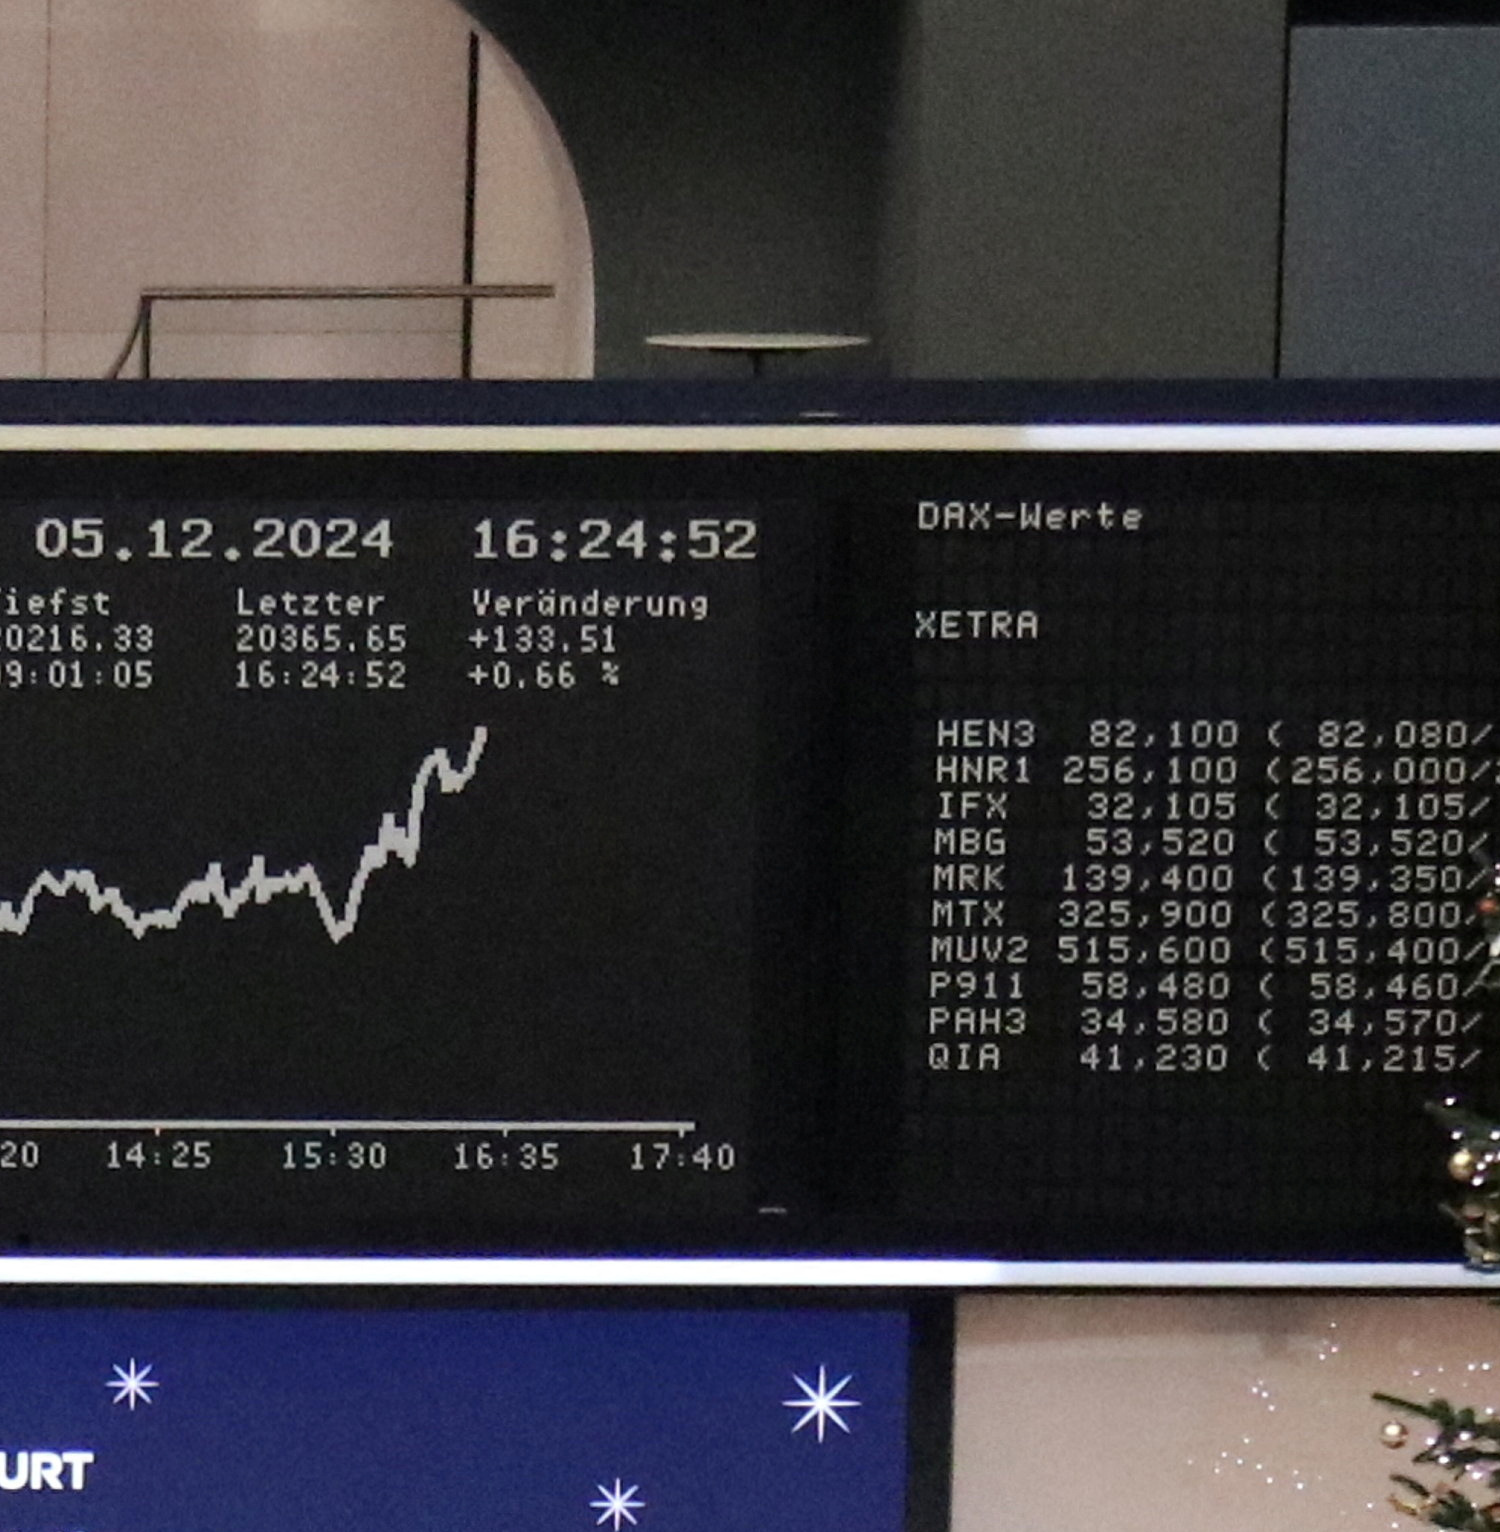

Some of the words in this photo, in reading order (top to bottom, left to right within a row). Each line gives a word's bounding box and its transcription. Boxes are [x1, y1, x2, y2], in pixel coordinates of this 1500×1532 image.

[918, 500, 1143, 531] DAX-Werte
[35, 517, 394, 562] 05.12.2024
[474, 518, 757, 563] 16:24:52
[237, 587, 385, 616] Letzter
[472, 588, 708, 621] Veränderung
[236, 623, 407, 653] 20365.65
[468, 624, 616, 653] +133.51
[915, 610, 1038, 639] XETRA
[236, 659, 406, 689] 16:24:52
[467, 660, 576, 689] +0.66
[601, 660, 620, 686] %
[937, 719, 1035, 748] HEN3
[1089, 718, 1239, 749] 82,100
[936, 755, 1030, 784] HNR1
[1063, 755, 1237, 785] 256,100
[939, 791, 1008, 820] IFX
[1087, 791, 1236, 821] 32,105
[934, 827, 1006, 856] MBG
[1086, 827, 1235, 856] 53,520
[933, 863, 1005, 891] MRK
[1063, 863, 1233, 893] 139,400
[932, 899, 1004, 928] MTX
[1058, 899, 1232, 929] 325,900
[931, 935, 1029, 964] MUV2
[1057, 935, 1231, 964] 515,600
[930, 970, 1023, 999] P911
[1081, 971, 1230, 1000] 58,480
[929, 1006, 1026, 1035] PAH3
[1080, 1006, 1229, 1036] 34,580
[928, 1042, 1000, 1071] QIA
[1079, 1043, 1228, 1072] 41,230
[107, 1140, 211, 1169] 14:25
[283, 1141, 386, 1169] 15:30
[455, 1142, 559, 1170] 16:35
[631, 1142, 735, 1171] 17:40
